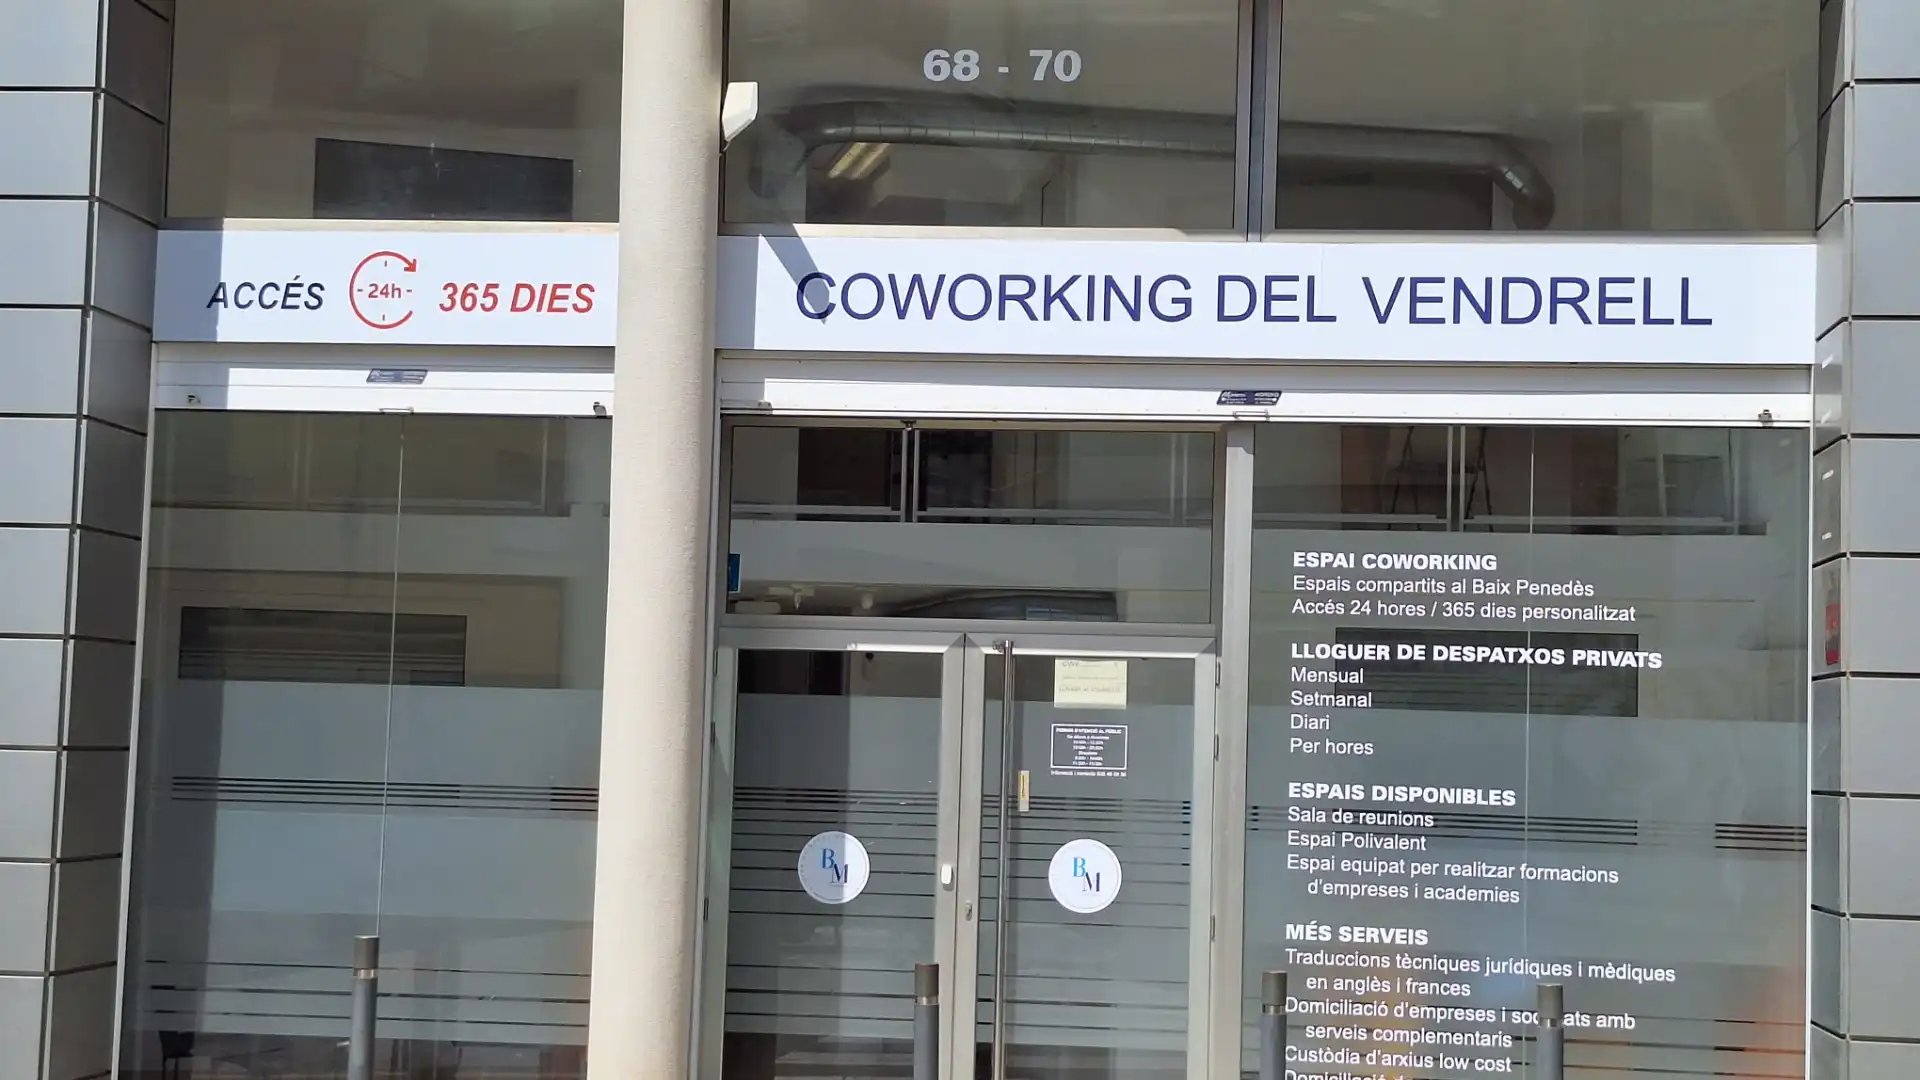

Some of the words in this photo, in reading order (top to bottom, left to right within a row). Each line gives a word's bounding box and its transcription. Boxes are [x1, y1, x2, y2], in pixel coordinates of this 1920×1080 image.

[922, 49, 981, 82] 68
[1028, 49, 1082, 82] 70
[206, 275, 325, 311] ACCÉS
[367, 281, 402, 299] 24h
[439, 282, 499, 313] 365
[510, 283, 595, 313] DIES
[796, 272, 1193, 322] COWORKING
[1216, 275, 1337, 323] DEL
[1362, 276, 1712, 326] VENDRELL
[1293, 551, 1355, 569] ESPAI
[1362, 553, 1498, 571] COWORKING
[1293, 576, 1351, 596] Espais
[1356, 578, 1446, 597] compartits
[1451, 579, 1466, 595] al
[1472, 579, 1510, 596] Baix
[1516, 580, 1594, 597] Penedès
[1292, 599, 1345, 616] Accés
[1350, 601, 1372, 616] 24
[1377, 601, 1426, 617] hores
[1431, 601, 1437, 617] /
[1442, 603, 1475, 618] 365
[1480, 602, 1516, 619] dies
[1522, 603, 1636, 623] personalitzat
[1291, 643, 1390, 661] LLOGUER
[1397, 645, 1426, 661] DE
[1433, 646, 1565, 666] DESPATXOS
[1572, 649, 1662, 668] PRIVATS
[1291, 667, 1364, 684] Mensual
[1290, 691, 1372, 709] Setmanal
[1290, 714, 1330, 730] Diari
[1290, 738, 1320, 754] Per
[1325, 739, 1374, 756] hores
[1288, 782, 1365, 801] ESPAIS
[1372, 785, 1516, 807] DISPONIBLES
[1288, 806, 1326, 824] Sala
[1331, 808, 1353, 824] de
[1359, 810, 1434, 828] reunions
[1287, 831, 1336, 851] Espai
[1341, 833, 1427, 851] Polivalent
[1286, 855, 1335, 875] Espai
[1340, 856, 1405, 877] equipat
[1410, 861, 1439, 878] per
[1444, 860, 1515, 879] realitzar
[1520, 862, 1619, 884] formacions
[1307, 879, 1409, 900] d'empreses
[1414, 883, 1419, 899] i
[1424, 884, 1520, 904] academies
[1285, 921, 1332, 941] MÉS
[1338, 926, 1429, 946] SERVEIS
[1285, 948, 1390, 969] Traduccions
[1395, 952, 1480, 975] tècniques
[1484, 956, 1573, 978] jurídiques
[1577, 961, 1582, 977] i
[1588, 962, 1676, 983] mèdiques
[1306, 977, 1328, 991] en
[1333, 975, 1391, 996] anglès
[1396, 978, 1401, 993] i
[1405, 978, 1471, 997] frances
[1285, 996, 1389, 1018] Domiciliació
[1393, 1001, 1496, 1023] d'empreses
[1501, 1006, 1506, 1023] i
[1511, 1009, 1591, 1028] socats
[1595, 1012, 1636, 1030] amb
[1305, 1022, 1367, 1041] serveis
[1372, 1025, 1513, 1048] complementaris
[1285, 1046, 1361, 1066] Custòdia
[1365, 1049, 1434, 1069] d'arxius
[1439, 1053, 1469, 1070] low
[1474, 1055, 1512, 1073] cost
